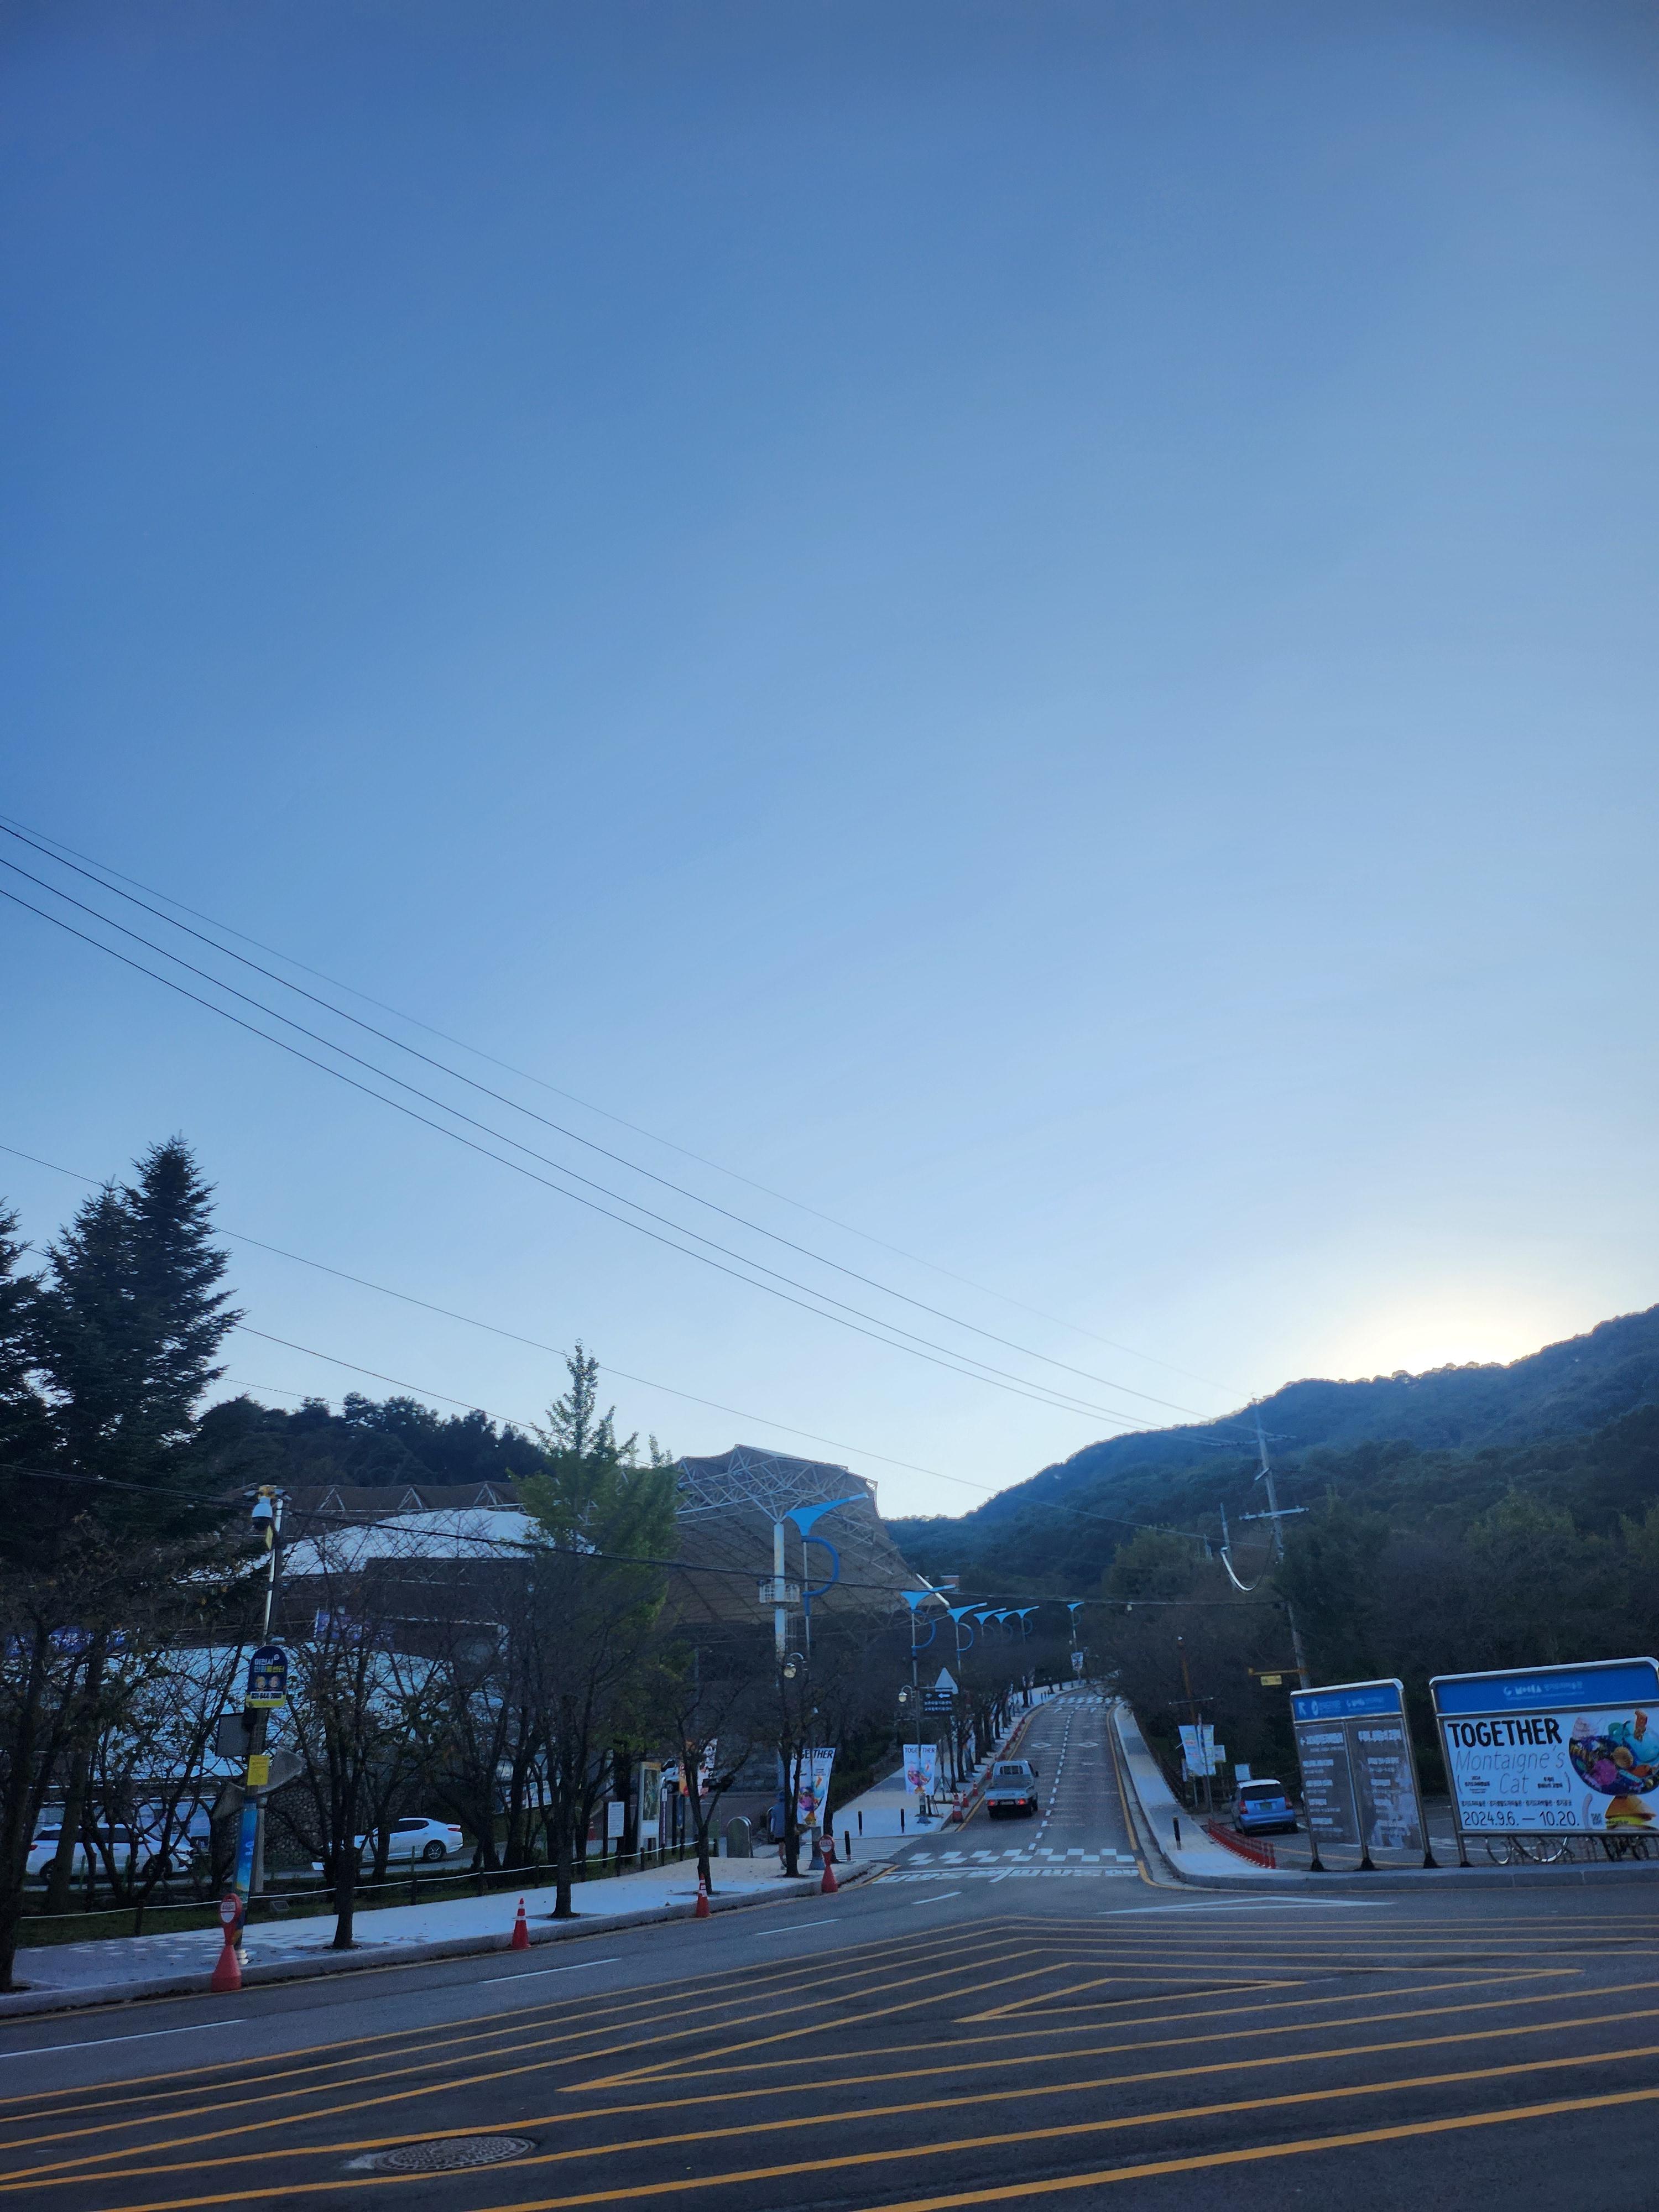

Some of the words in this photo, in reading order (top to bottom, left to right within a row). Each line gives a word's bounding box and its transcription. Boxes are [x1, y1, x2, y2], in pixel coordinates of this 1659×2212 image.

[1447, 1718, 1562, 1748] TOGETHER
[1455, 1745, 1566, 1773] Montaigne's
[1499, 1773, 1530, 1794] Cat
[1463, 1811, 1519, 1826] 2024.9.6.
[1539, 1811, 1580, 1826] 10.20.
